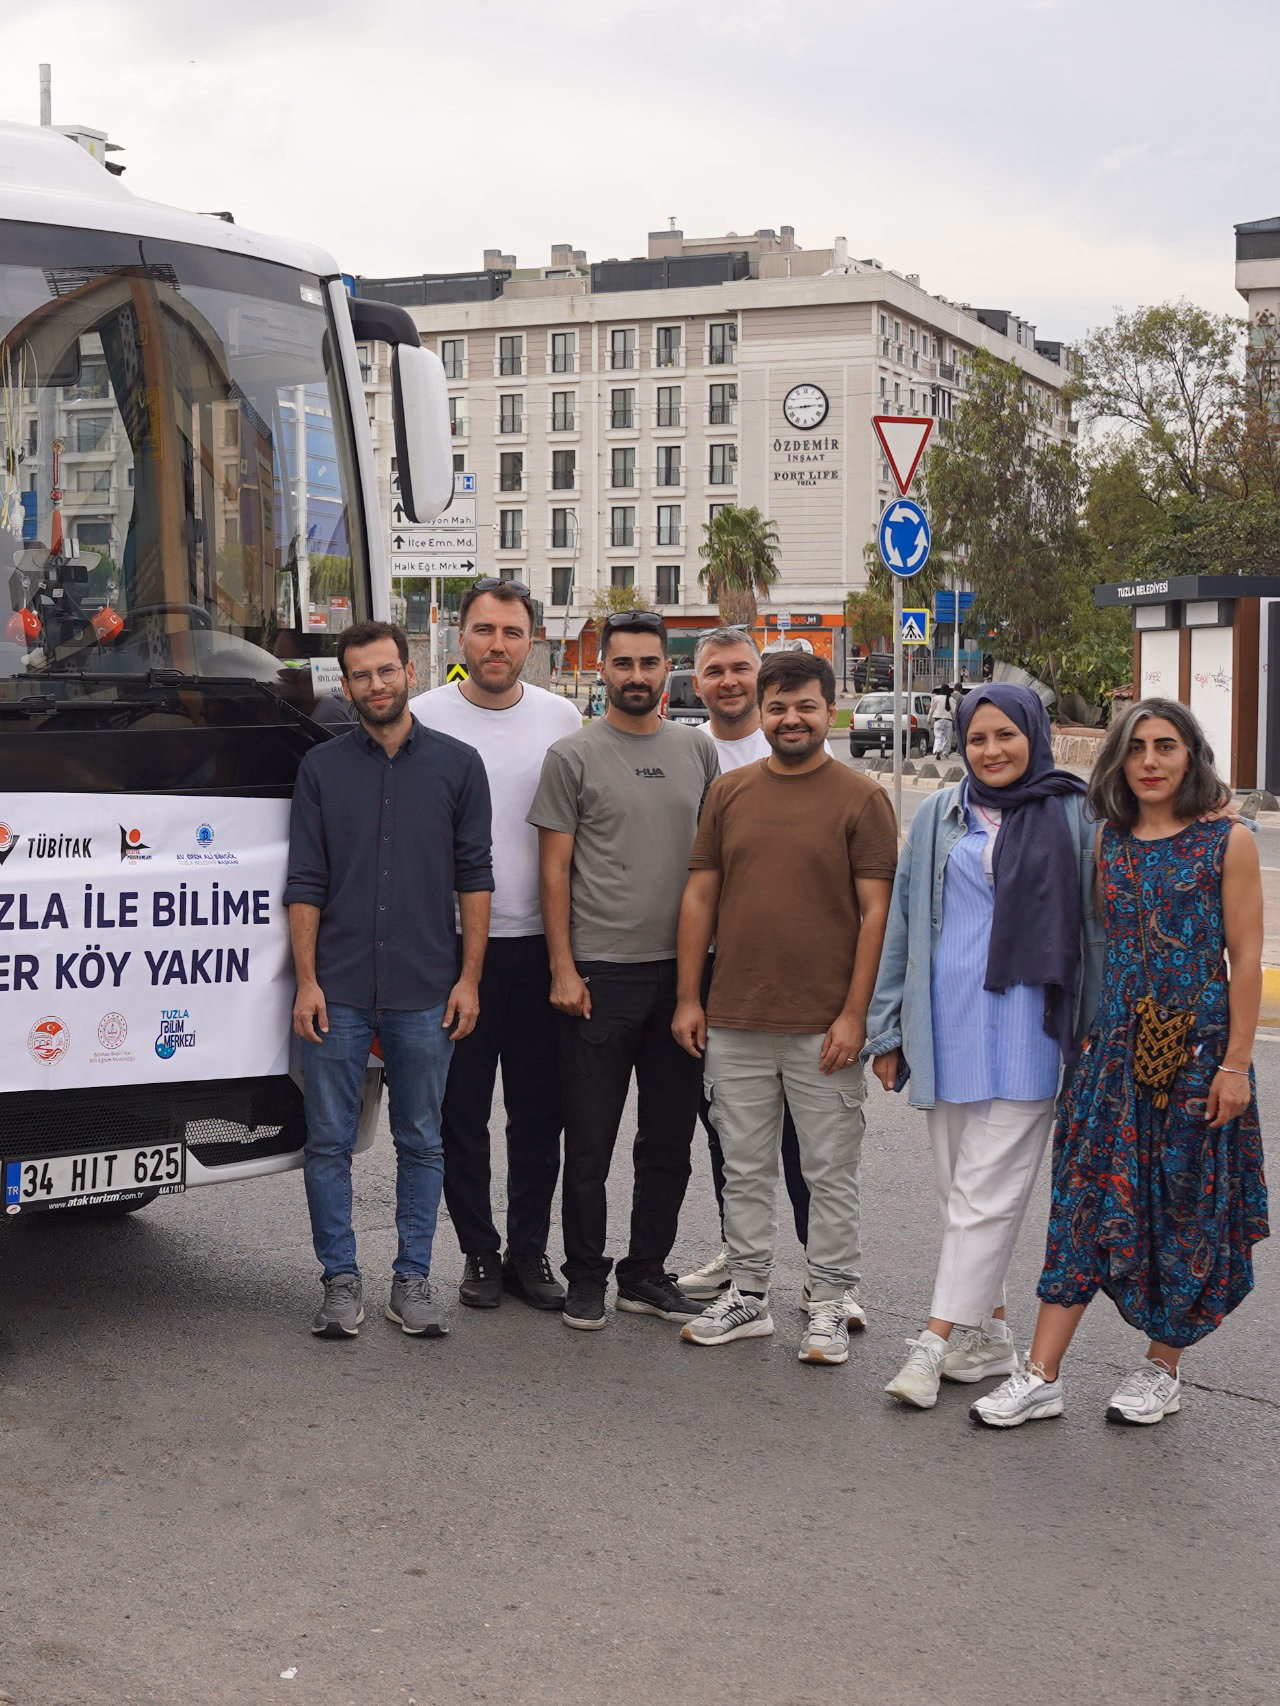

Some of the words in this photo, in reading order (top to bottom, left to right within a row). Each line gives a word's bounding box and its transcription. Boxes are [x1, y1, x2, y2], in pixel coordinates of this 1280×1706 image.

[773, 437, 839, 452] ÖZDEMİR
[787, 454, 825, 463] İNŞAAT
[773, 471, 805, 481] PORT
[809, 470, 839, 480] LIFE
[451, 516, 474, 525] Mah.
[408, 536, 426, 548] İlçe
[428, 538, 455, 547] Emn.
[456, 538, 474, 547] Md.
[394, 562, 416, 571] Halk
[418, 562, 437, 573] Eğt.
[439, 562, 461, 571] Mrk.
[1117, 586, 1136, 598] TUZLA
[1136, 580, 1169, 596] BELEDİYESİ
[28, 833, 93, 859] TÜBİTAK
[84, 883, 139, 929] İLE
[152, 882, 270, 927] BİLİME
[55, 944, 132, 990] KÖY
[144, 948, 249, 986] YAKIN
[161, 1010, 189, 1019] TUZLA
[164, 1020, 184, 1033] BİLİM
[164, 1030, 196, 1048] MERKEZİ
[22, 1162, 54, 1198] 34
[71, 1154, 118, 1192] HIT
[134, 1146, 179, 1183] 625
[7, 1186, 19, 1196] TR
